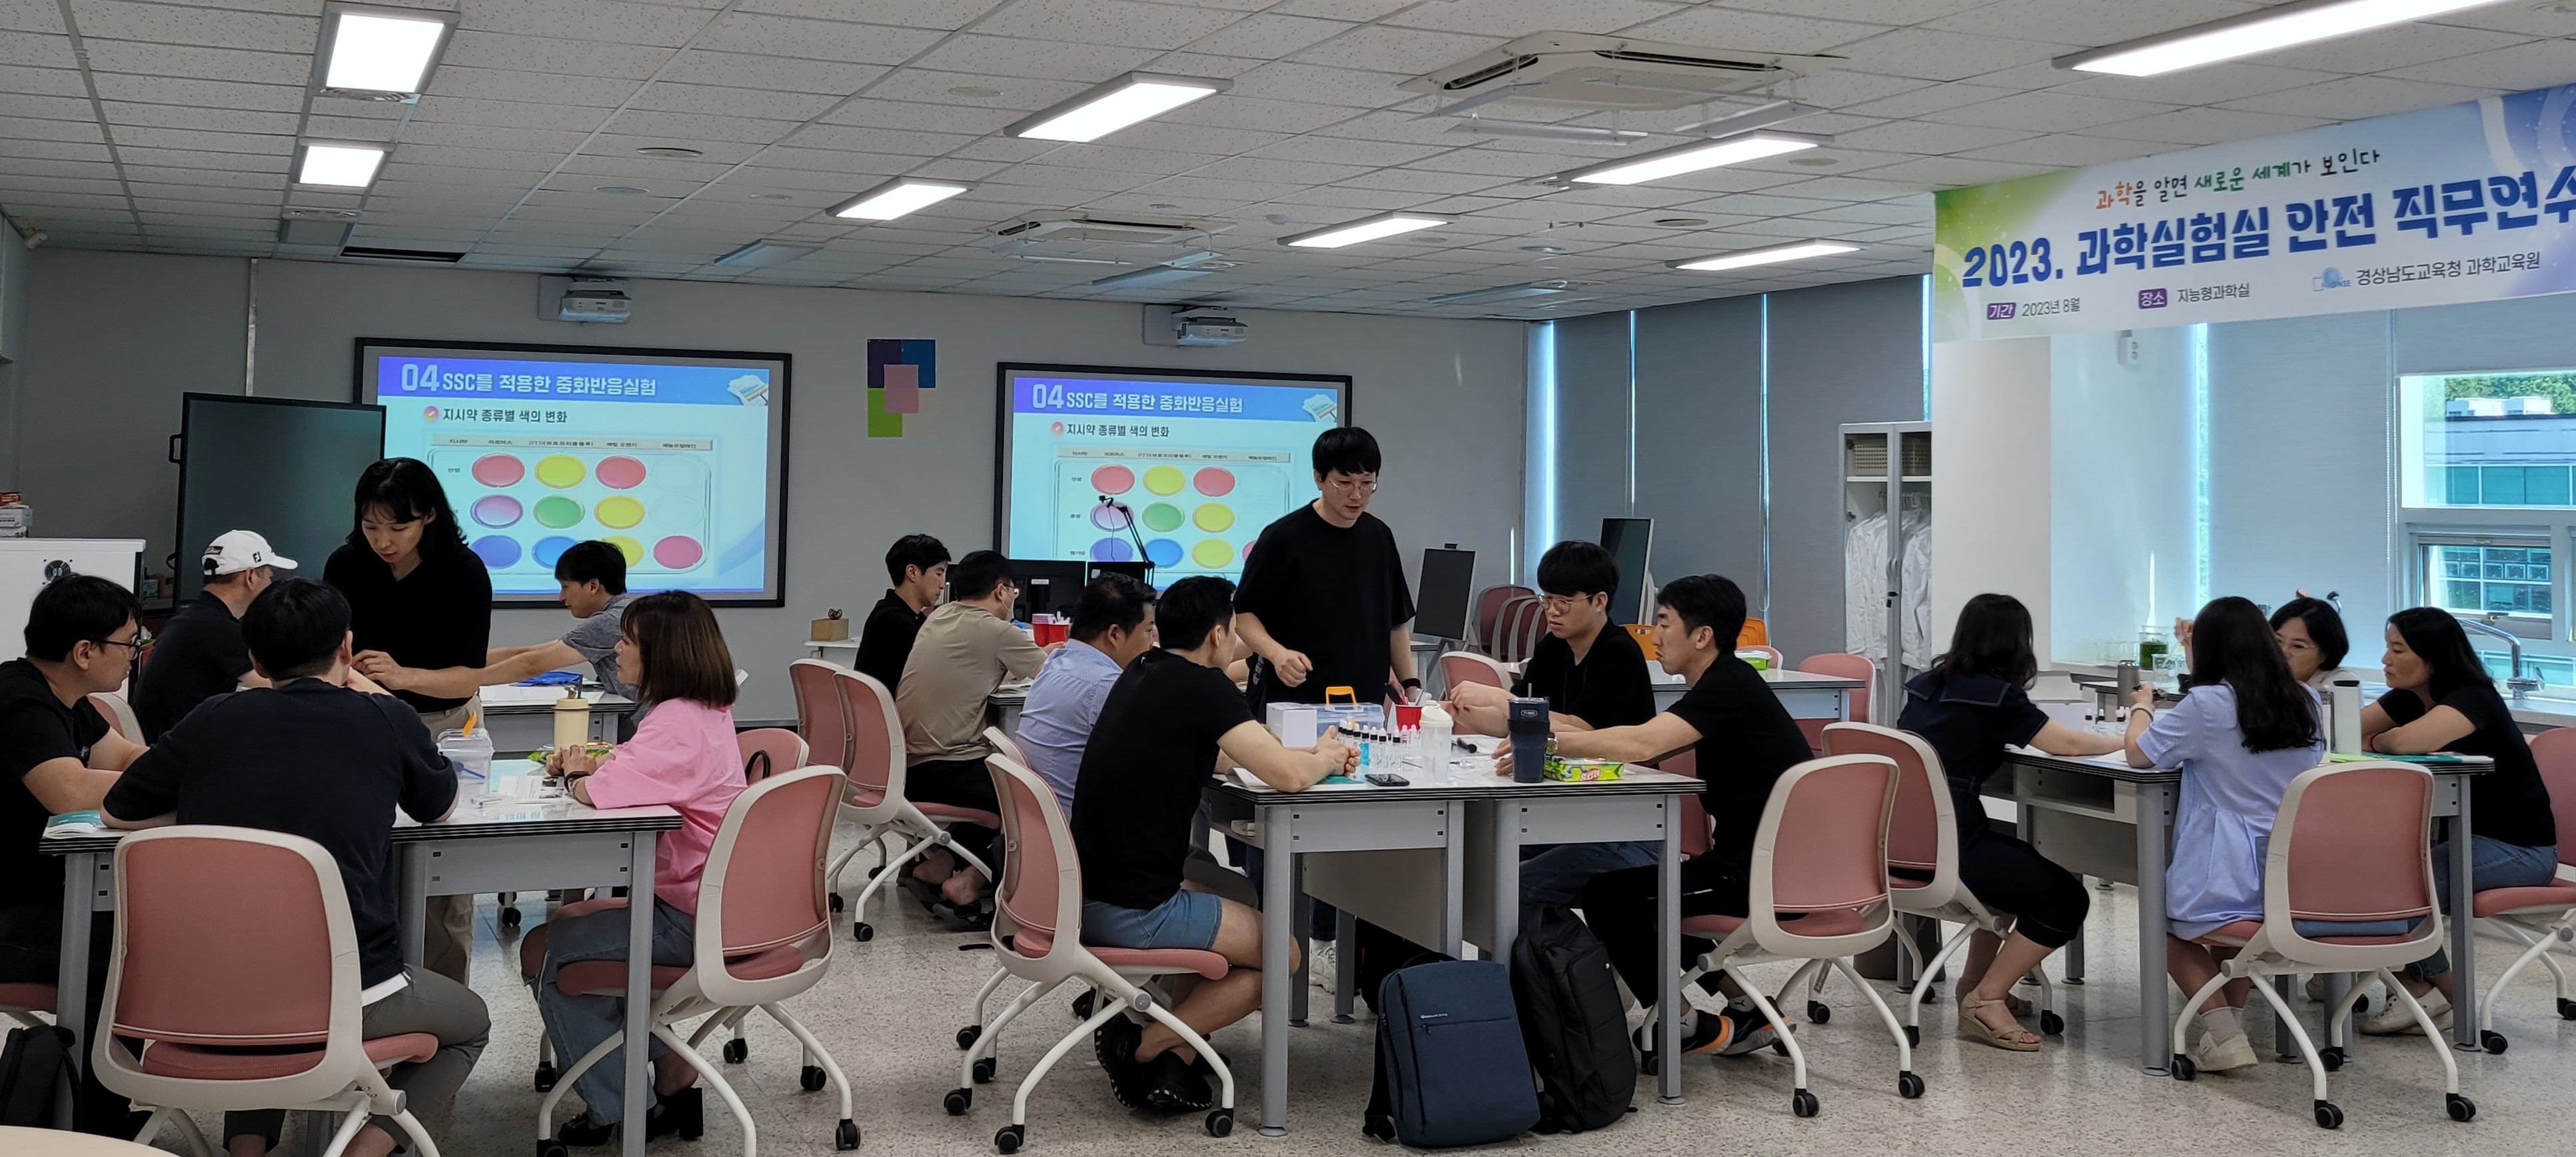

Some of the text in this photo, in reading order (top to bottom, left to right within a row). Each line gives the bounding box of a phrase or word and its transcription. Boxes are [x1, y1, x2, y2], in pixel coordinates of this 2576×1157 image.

[2096, 147, 2380, 209] 과학을 알면 새로운 세계가 보인다
[1962, 237, 2064, 288] 2023.
[2076, 206, 2270, 276] 과학실험실
[2285, 192, 2377, 253] 안전
[2355, 251, 2541, 287] 경상남도교육청 과학교육원
[1989, 297, 2080, 319] 기간 2023년 8월
[2140, 283, 2251, 307] 장소 지능형과학실
[401, 363, 656, 397] 04 SSC를 적용한 중화반응실험
[1032, 383, 1243, 413] 04 SSC를 적용한 중화반응실험
[442, 408, 568, 423] 지시약 종류별 색의 변화
[1067, 423, 1169, 437] 지시약 종류별 색의 변화
